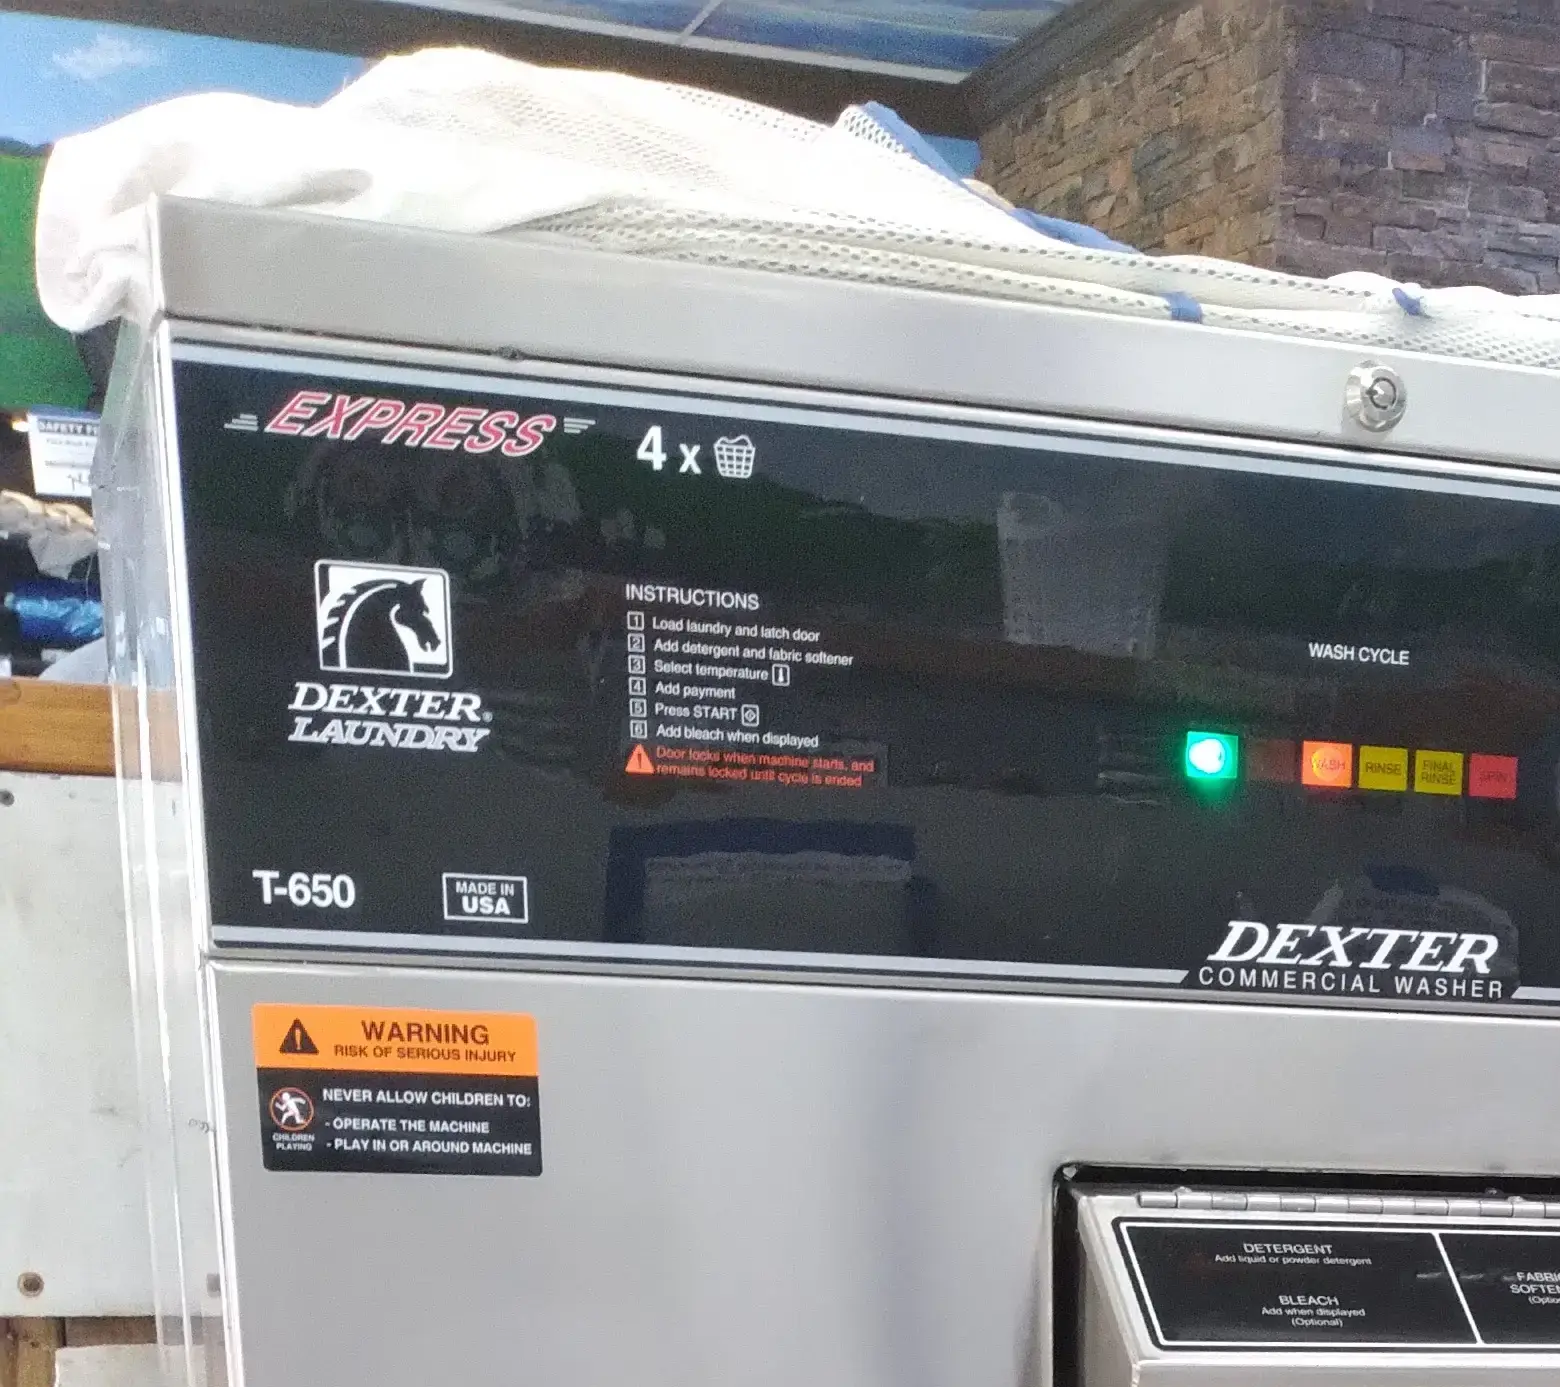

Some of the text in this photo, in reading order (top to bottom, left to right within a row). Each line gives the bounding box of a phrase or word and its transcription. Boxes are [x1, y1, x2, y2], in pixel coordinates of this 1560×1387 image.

[264, 391, 556, 457] EXPRESS
[636, 424, 668, 472] 4
[626, 584, 759, 610] INSTRUCTIONS
[653, 616, 820, 642] Load laundry and latch door
[654, 639, 853, 666] Add detergent and fabric softener
[1309, 641, 1409, 666] WASH CYCLE
[654, 660, 768, 680] Select temperature
[655, 681, 736, 700] Add payment
[655, 703, 737, 720] Press START
[288, 716, 490, 752] LAUNDRY
[656, 724, 818, 749] Add bleach when displayed
[1365, 762, 1401, 776] RINSE
[1423, 759, 1456, 774] FINAL
[1421, 772, 1456, 787] RINSE
[252, 870, 355, 908] T-650
[456, 882, 514, 896] MADE IN
[462, 896, 510, 915] USA
[1206, 920, 1499, 975] DEXTER
[1199, 966, 1504, 999] COMMERCIAL WASHER
[361, 1020, 489, 1044] WARNING
[334, 1044, 516, 1062] RISK OF SERIOUS INJURY
[322, 1088, 531, 1108] NEVER ALLOW CHILDREN TO:
[333, 1118, 490, 1134] OPERATE THE MACHINE
[334, 1139, 532, 1155] PLAY IN OR AROUND MACHINE
[1243, 1243, 1332, 1254] DETERGENT
[1215, 1254, 1236, 1262] Add
[1239, 1256, 1265, 1264] liquid
[1282, 1257, 1319, 1265] powder
[1323, 1257, 1372, 1266] detergent
[1278, 1295, 1339, 1306] BLEACH
[1262, 1307, 1365, 1318] Add when displayed
[1292, 1318, 1343, 1328] (Optional)
